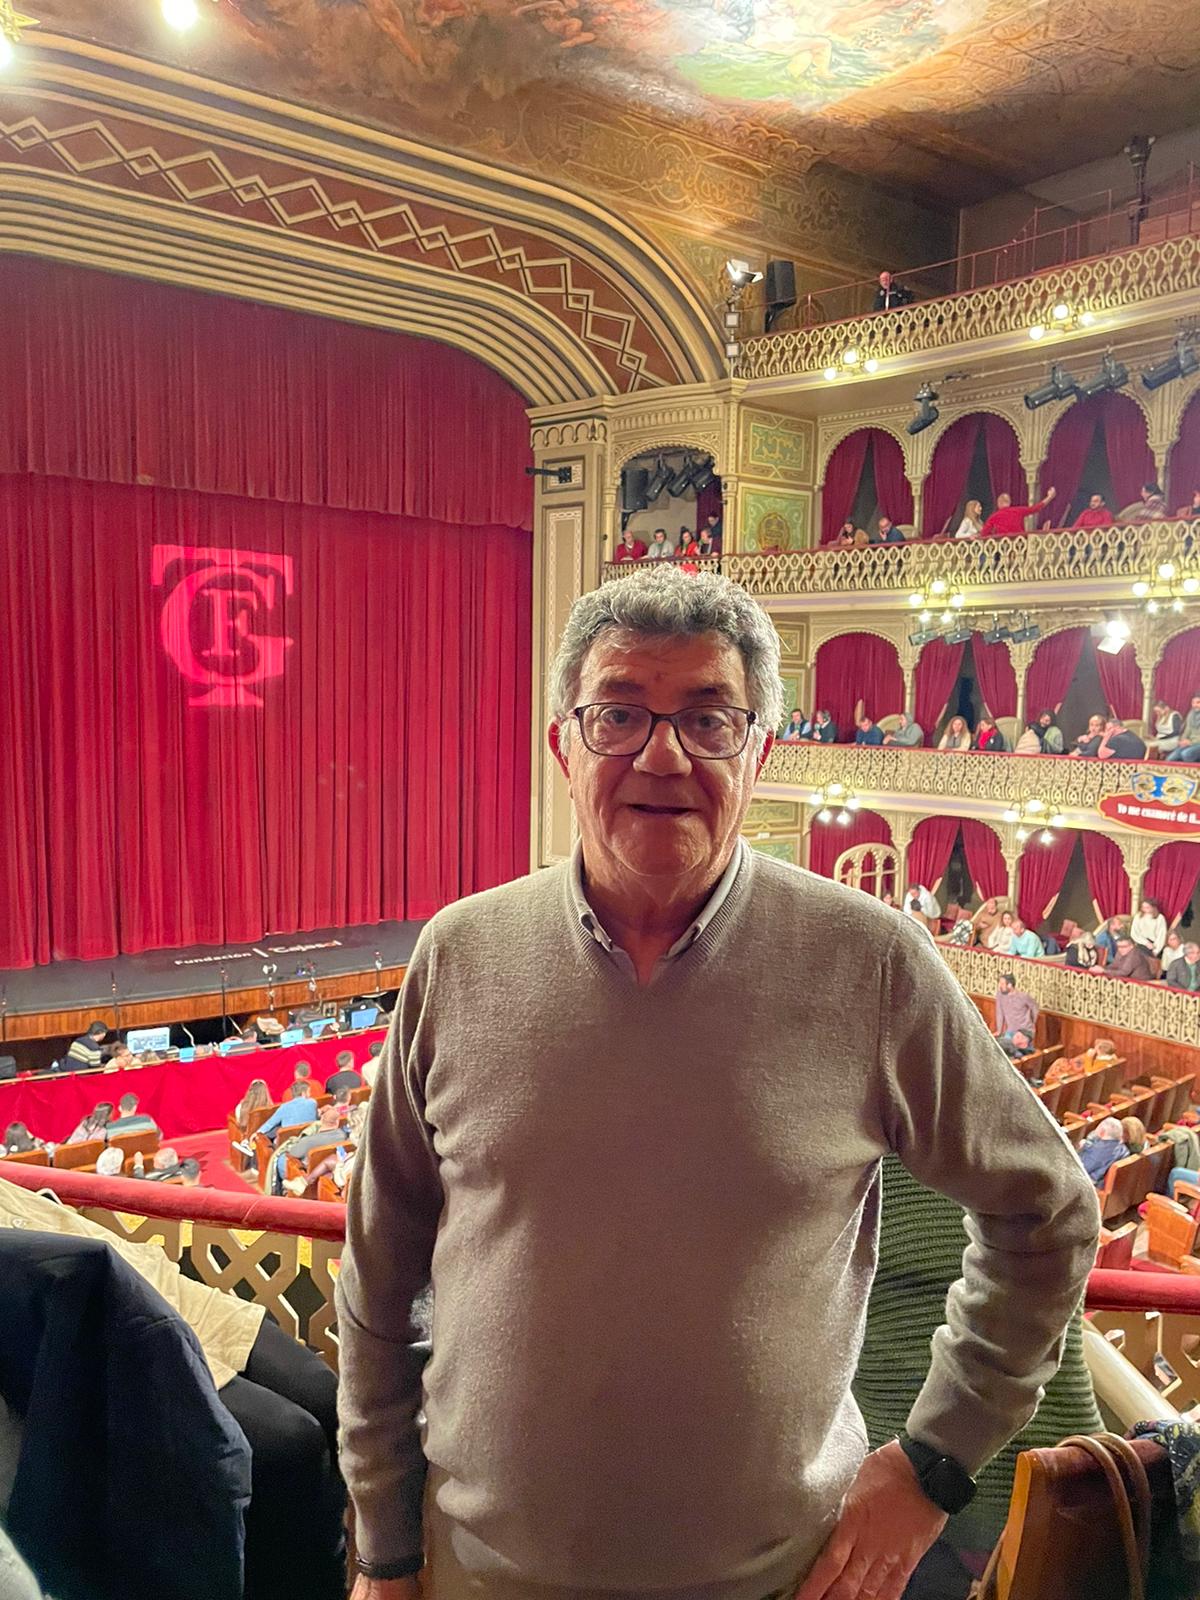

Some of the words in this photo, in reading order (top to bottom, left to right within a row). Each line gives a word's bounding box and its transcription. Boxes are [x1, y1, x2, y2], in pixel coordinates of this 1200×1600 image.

[1128, 806, 1140, 816] me
[1177, 812, 1188, 823] de
[174, 952, 252, 965] Fundación
